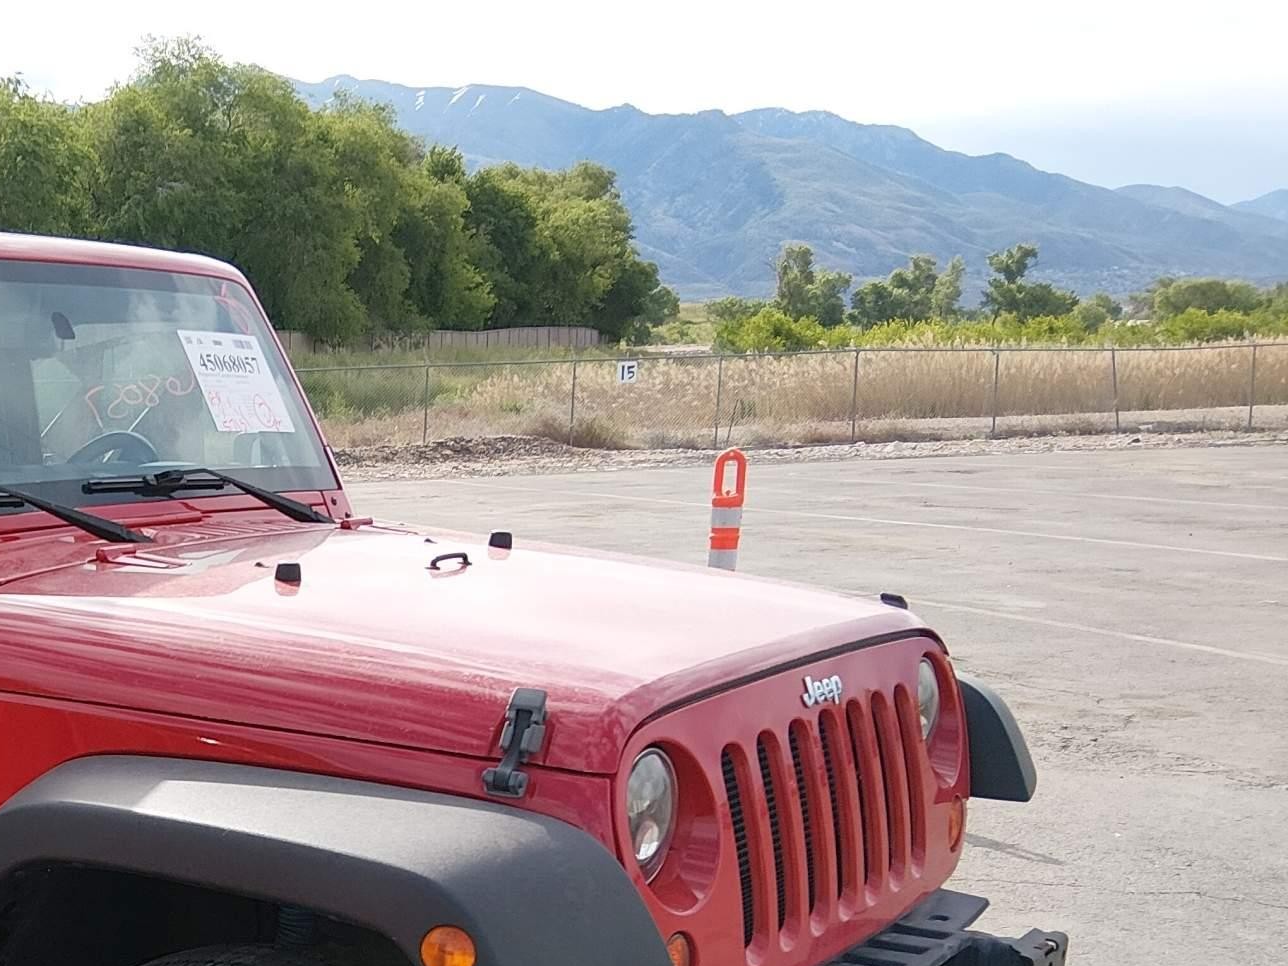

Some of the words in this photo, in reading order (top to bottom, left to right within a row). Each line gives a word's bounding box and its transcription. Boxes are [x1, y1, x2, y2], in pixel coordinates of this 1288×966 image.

[199, 353, 260, 374] 45068057
[621, 365, 635, 380] 15
[802, 674, 843, 708] Jeep
